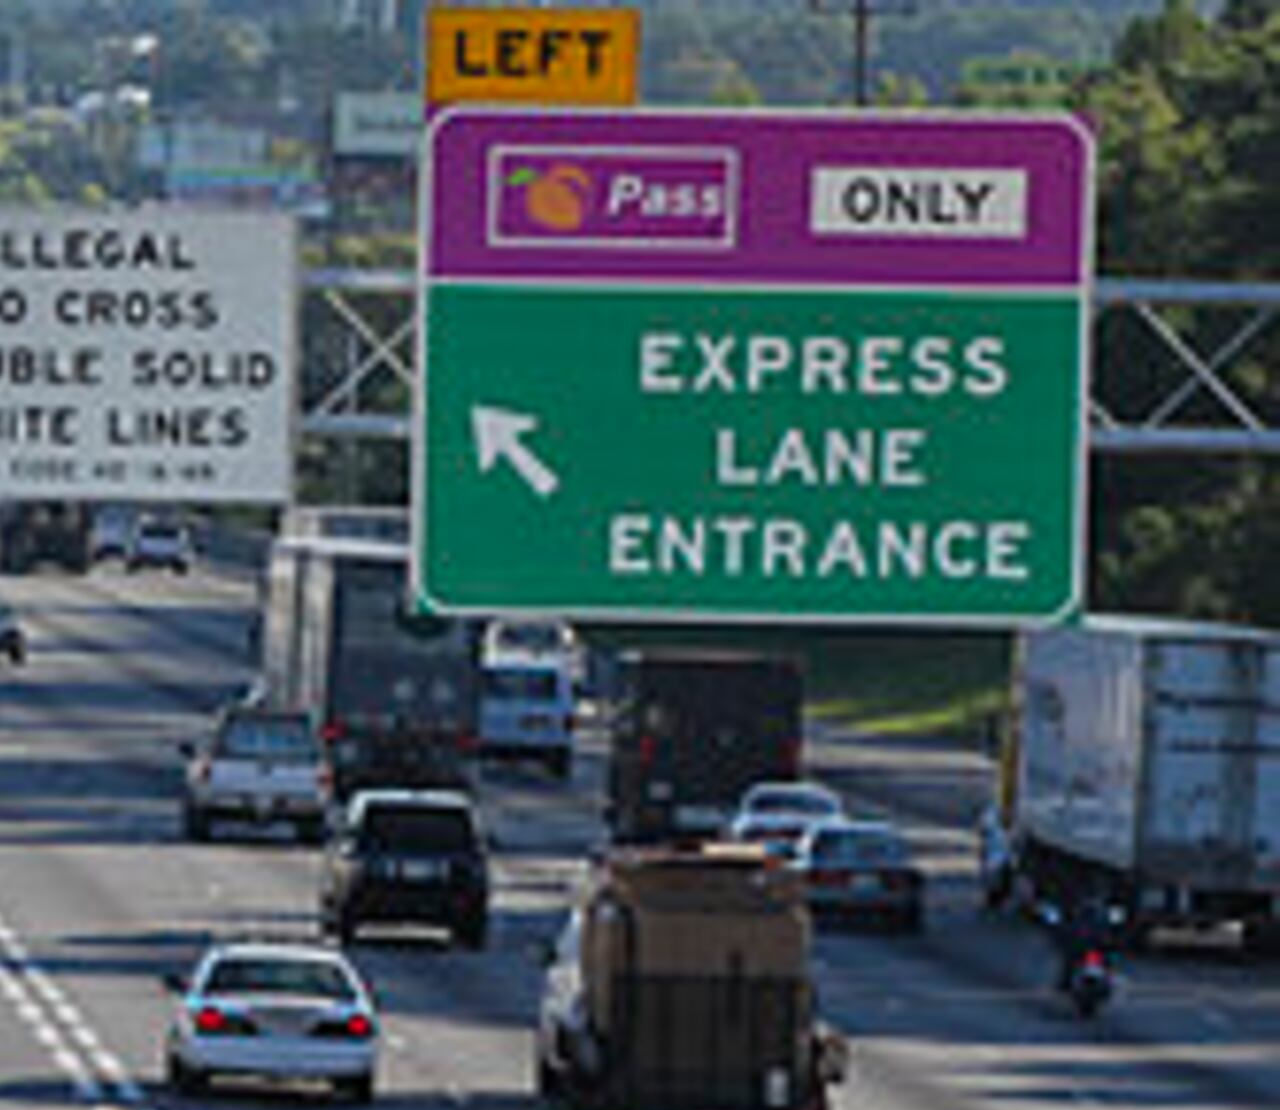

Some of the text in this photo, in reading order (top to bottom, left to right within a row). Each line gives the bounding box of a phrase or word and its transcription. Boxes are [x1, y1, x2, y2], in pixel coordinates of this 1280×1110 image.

[453, 28, 612, 80] LEFT
[606, 173, 996, 224] Pass ONLY
[53, 288, 220, 331] CROSS
[131, 348, 277, 391] SOLID
[639, 333, 1007, 396] EXPRESS
[106, 406, 250, 449] LINES
[716, 427, 925, 487] LANE
[608, 514, 1030, 580] ENTRANCE
